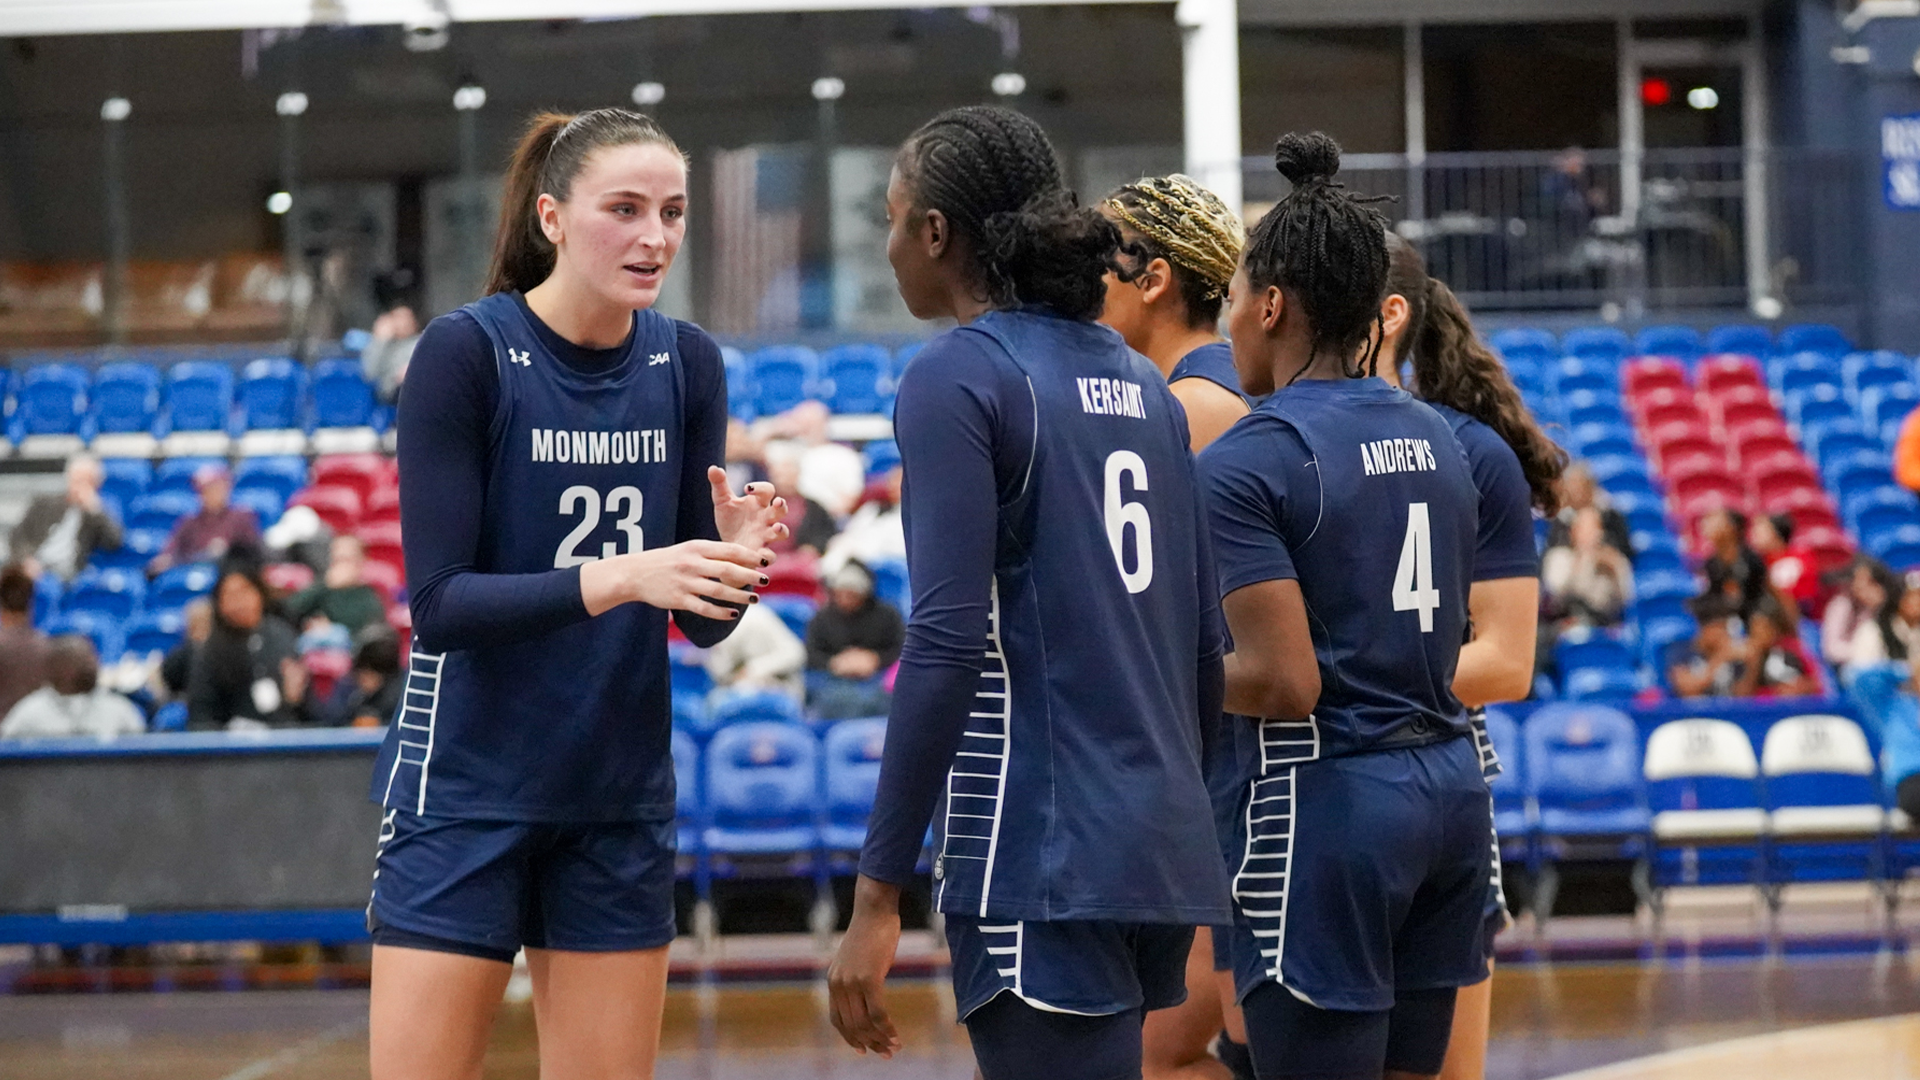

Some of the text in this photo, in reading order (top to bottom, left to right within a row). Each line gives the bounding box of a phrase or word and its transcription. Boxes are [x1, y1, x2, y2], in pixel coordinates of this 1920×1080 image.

[531, 428, 667, 465] MONMOUTH
[1360, 438, 1437, 476] ANDREWS
[553, 485, 644, 569] 23
[1104, 450, 1153, 594] 6
[1391, 502, 1440, 633] 4
